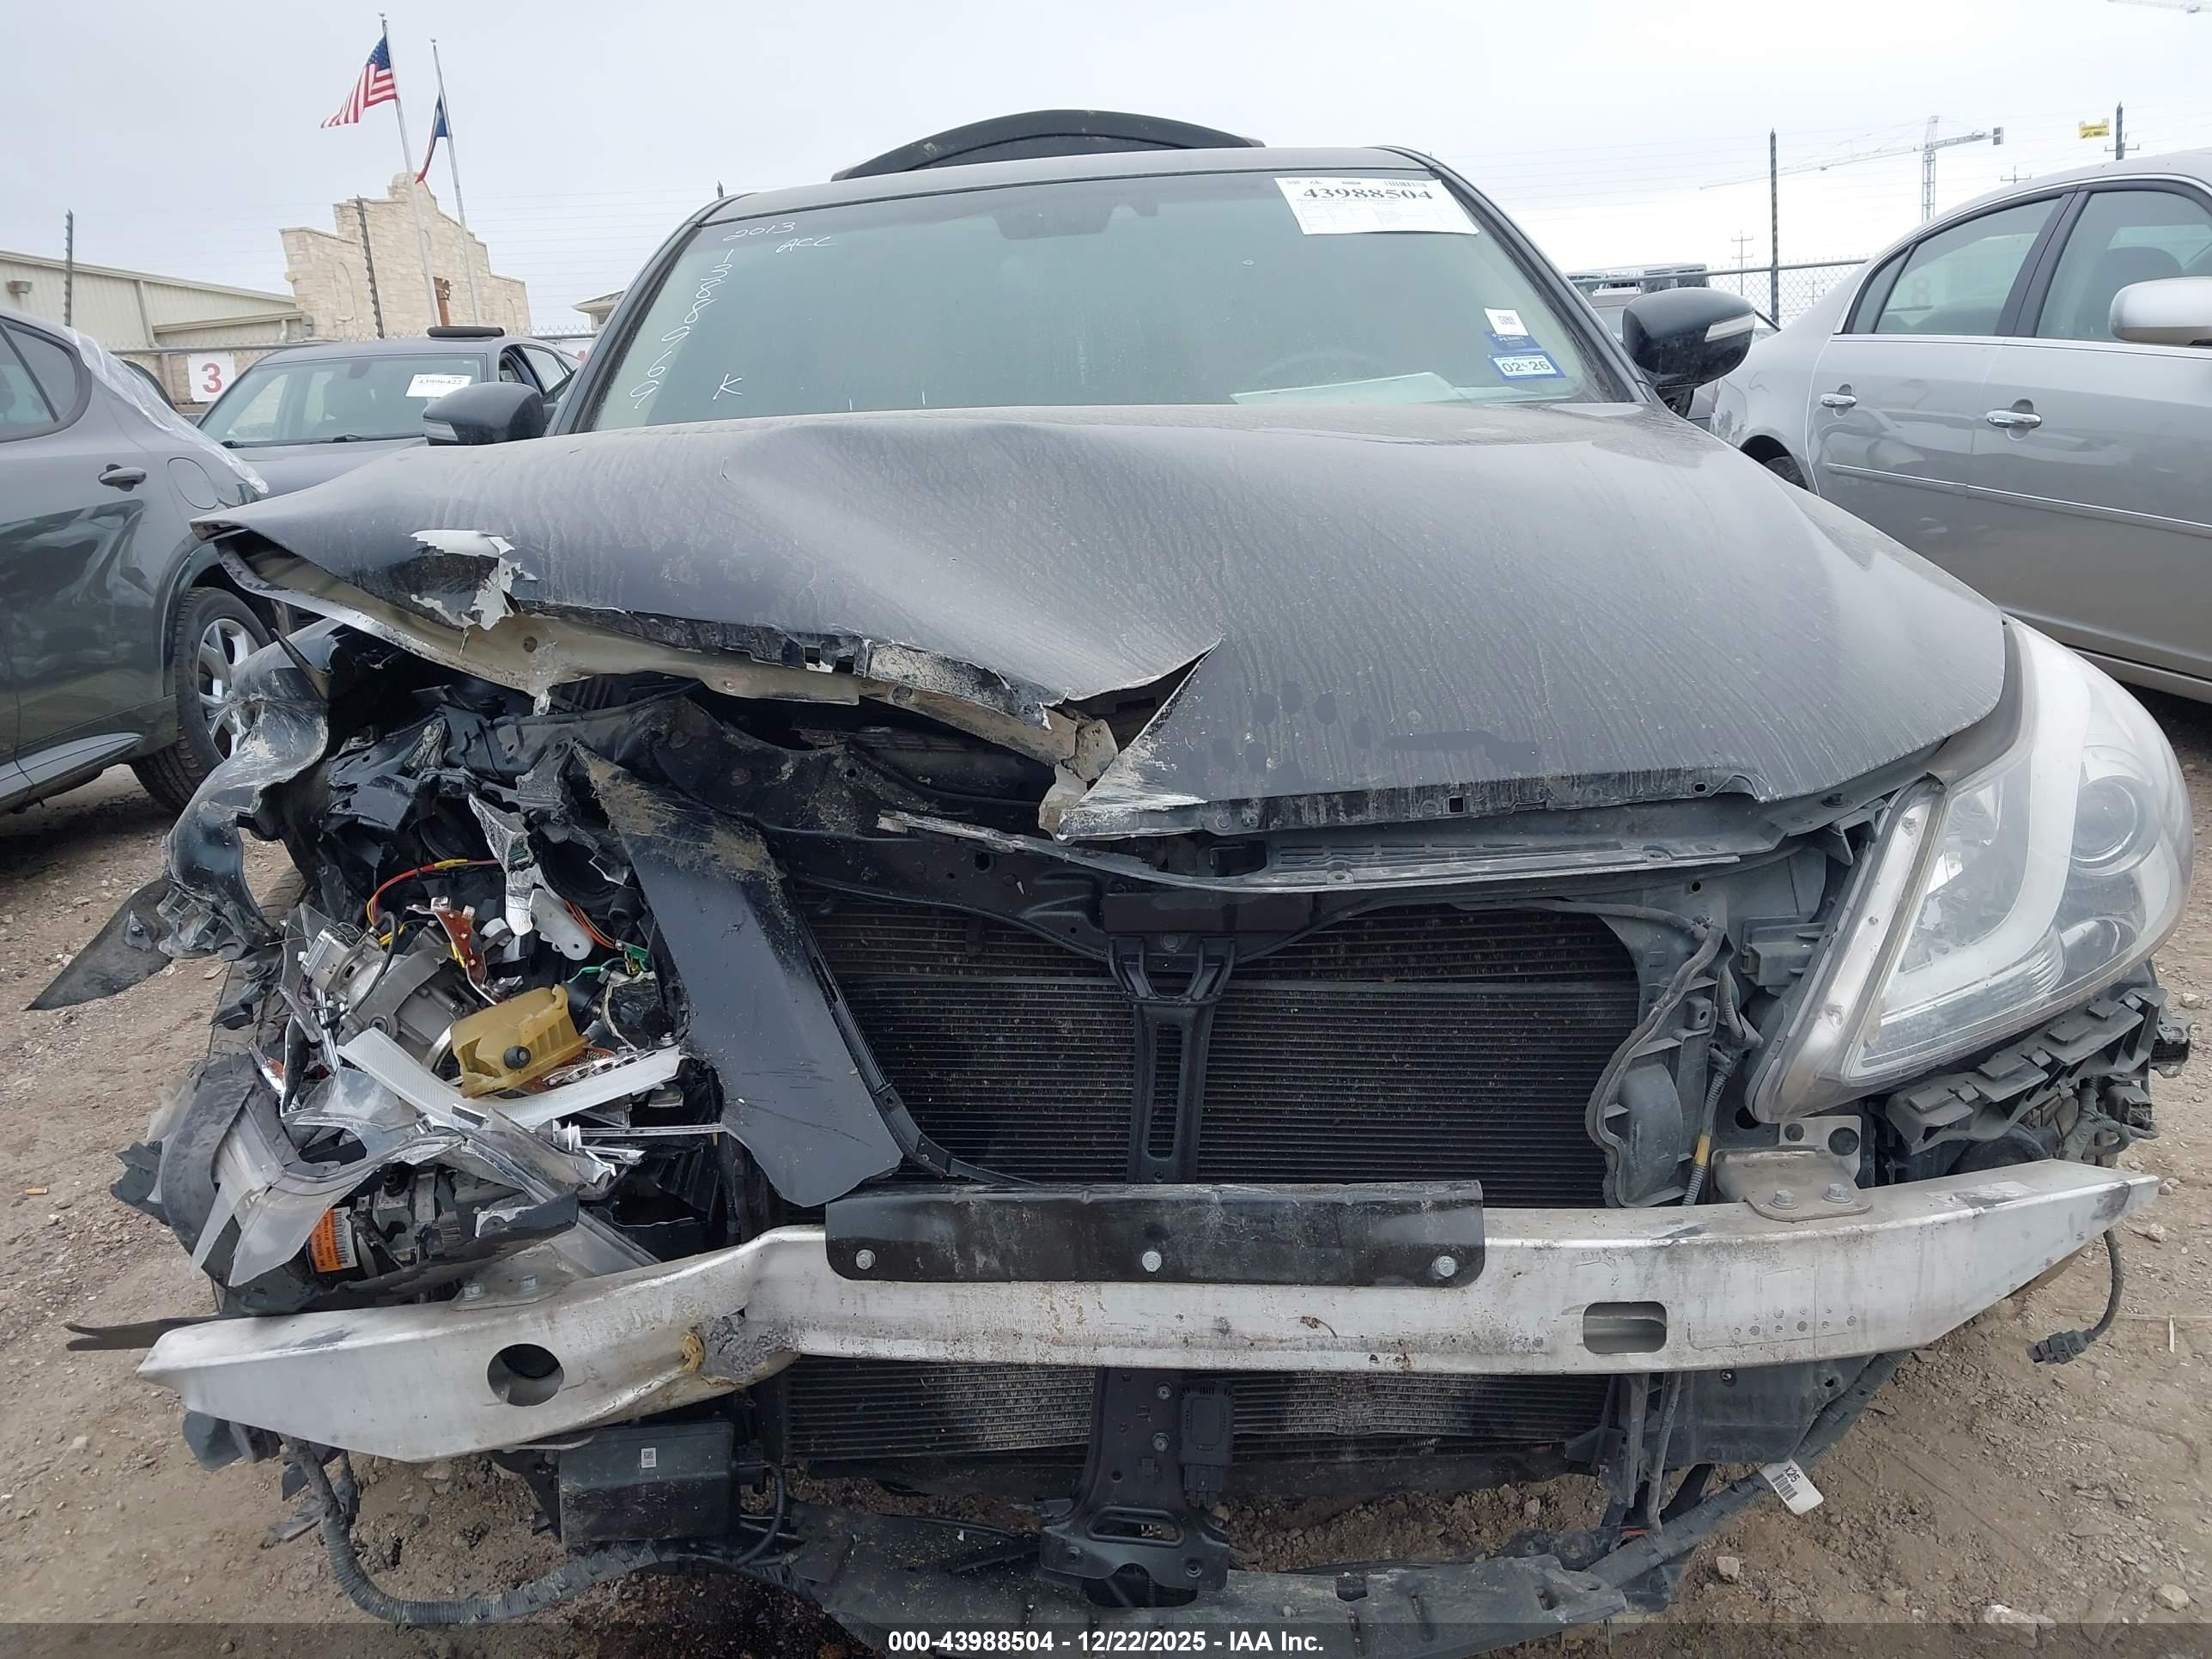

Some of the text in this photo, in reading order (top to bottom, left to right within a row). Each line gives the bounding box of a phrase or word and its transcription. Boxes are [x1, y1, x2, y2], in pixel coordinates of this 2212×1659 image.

[1303, 187, 1434, 200] 43988504
[722, 222, 796, 241] 2013
[201, 362, 222, 393] 3
[713, 373, 743, 400] K
[1783, 1464, 1801, 1483] X25
